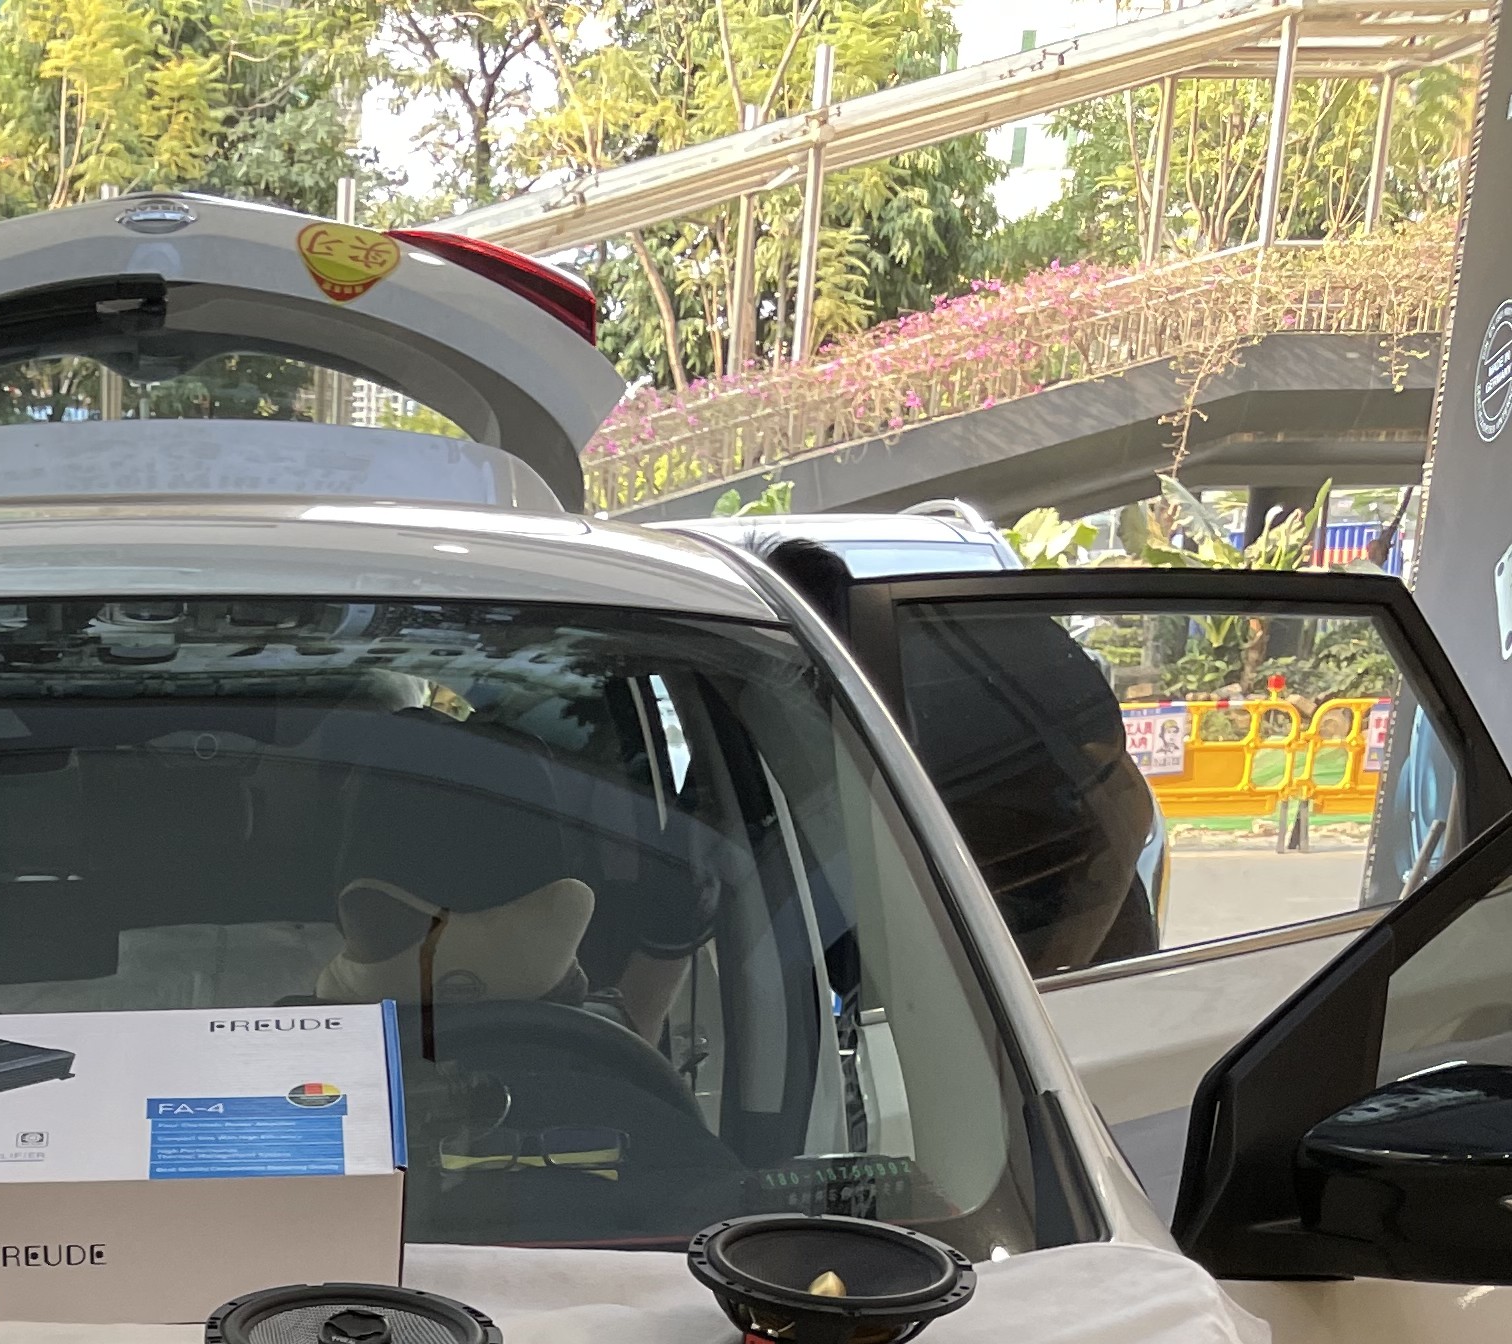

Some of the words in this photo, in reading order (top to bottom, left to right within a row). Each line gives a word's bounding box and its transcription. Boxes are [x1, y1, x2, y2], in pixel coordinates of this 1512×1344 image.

[1485, 361, 1512, 394] GERMAN
[209, 1017, 344, 1033] FREUDE
[158, 1102, 225, 1115] FA-4
